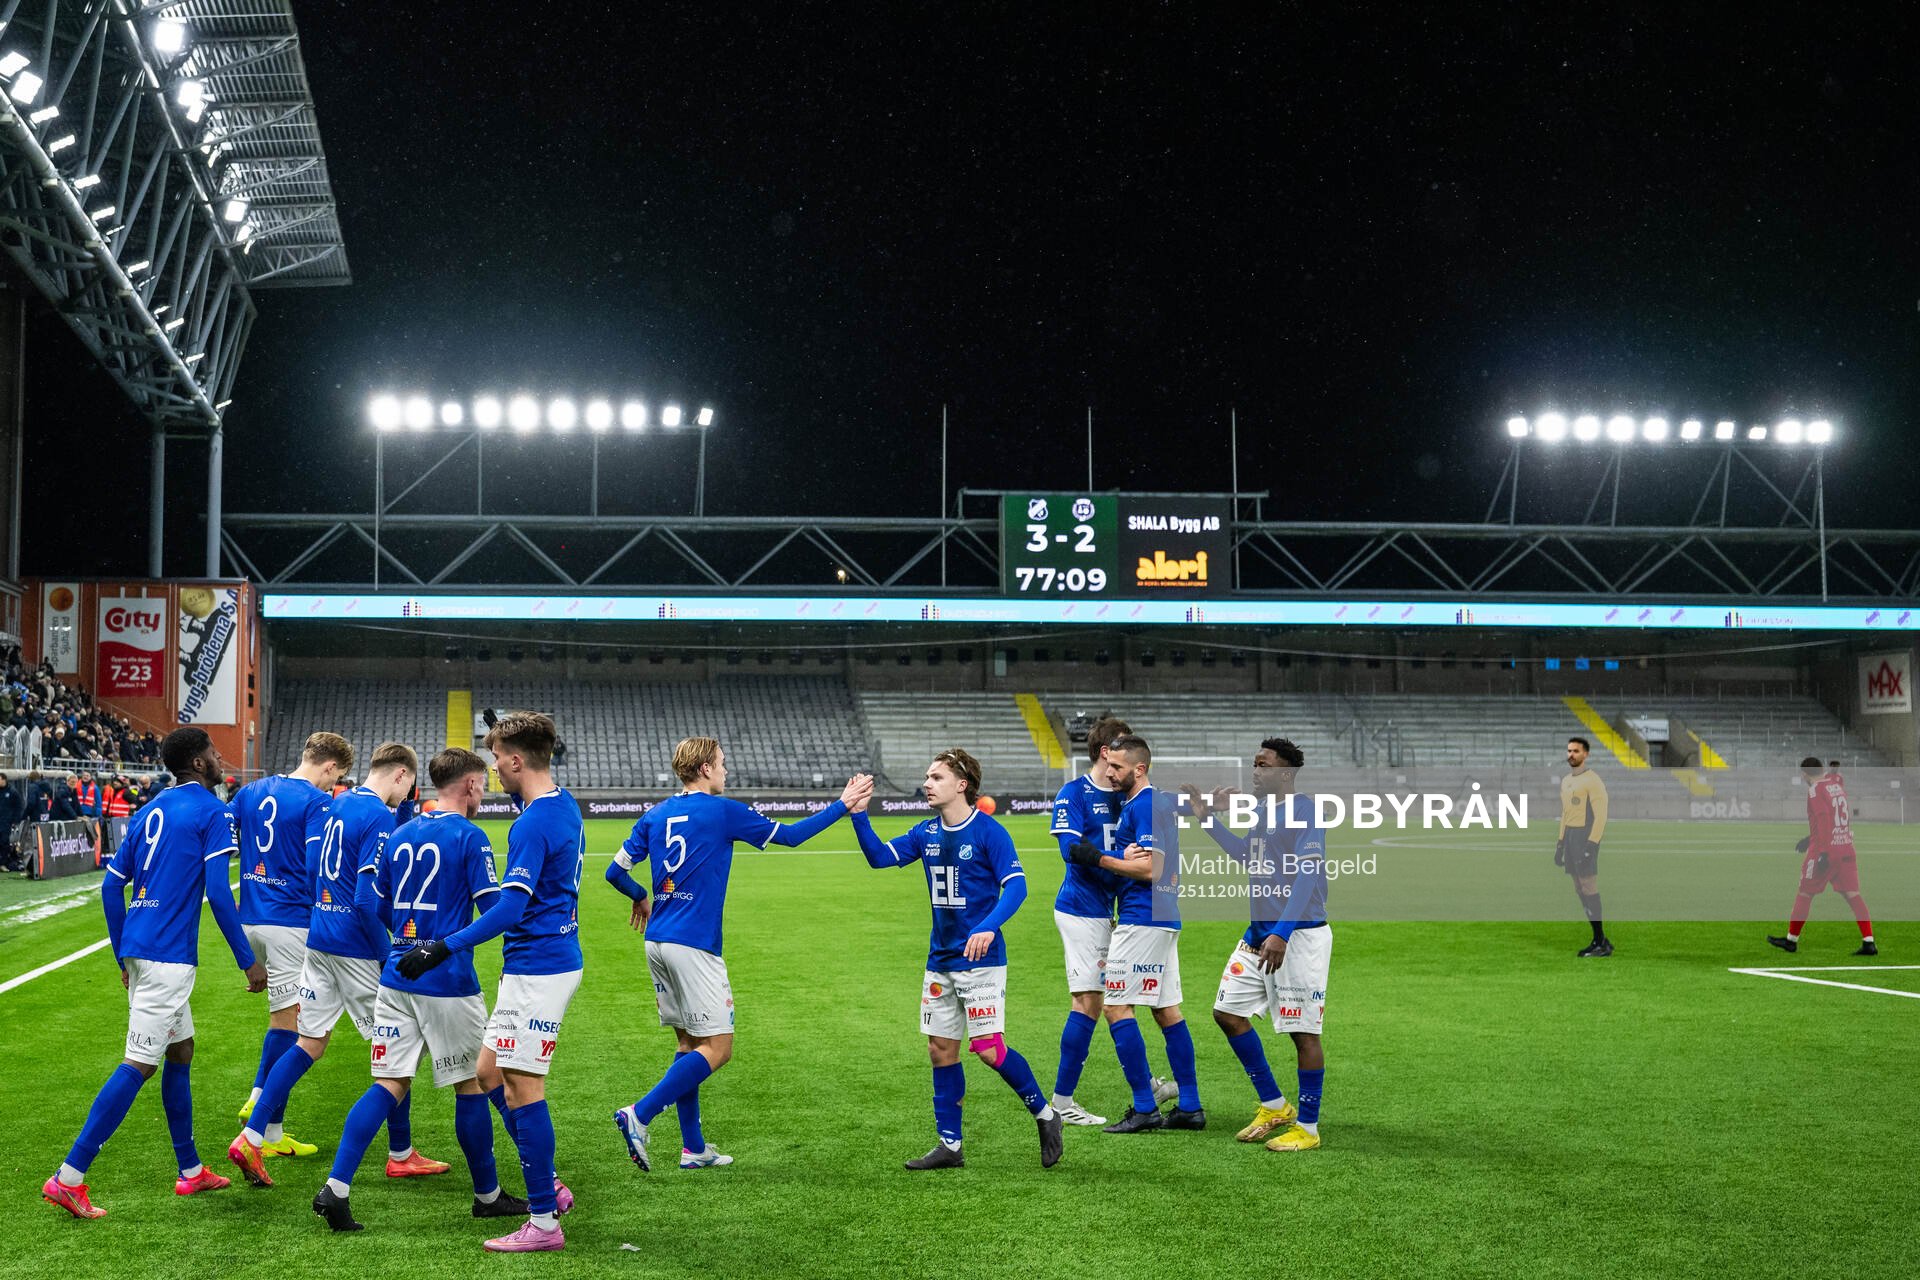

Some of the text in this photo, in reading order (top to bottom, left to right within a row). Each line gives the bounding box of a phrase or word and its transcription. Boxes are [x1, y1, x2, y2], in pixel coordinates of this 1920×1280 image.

[1128, 515, 1220, 533] SHALA Bygg AB
[1026, 524, 1048, 552] 3
[1073, 524, 1096, 552] 2
[1015, 567, 1107, 591] 77:09
[104, 607, 161, 633] City
[48, 616, 60, 667] Sparbanen
[111, 665, 152, 681] 7-23
[1869, 660, 1902, 698] MAX
[589, 802, 644, 814] Sparbanken
[753, 801, 806, 812] Sparbanken
[882, 799, 929, 811] Sparbanke
[1690, 796, 1751, 819] BORÅS
[1832, 796, 1849, 827] 13
[255, 795, 278, 853] 3
[145, 807, 164, 871] 9
[319, 816, 344, 881] 10
[663, 815, 689, 873] 5
[393, 842, 441, 911] 22
[930, 865, 966, 906] EL
[923, 1011, 932, 1025] 17
[968, 1007, 996, 1019] MAXI
[1280, 1006, 1302, 1017] MAXI
[129, 1031, 152, 1047] RLA
[496, 1038, 516, 1049] AXI
[435, 1054, 470, 1070] ERLA
